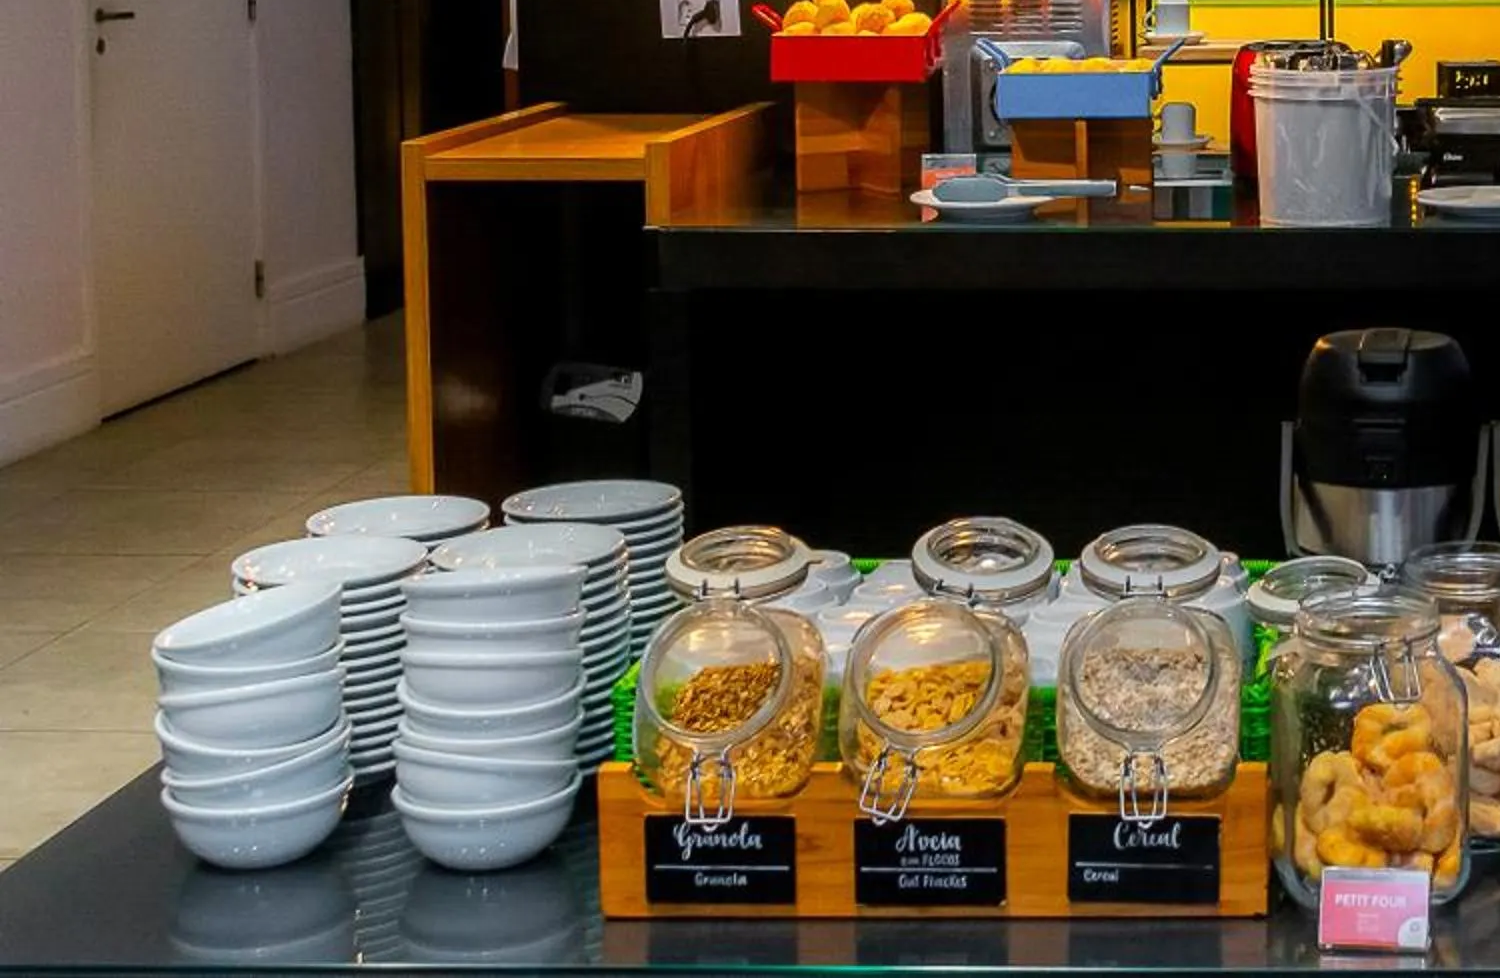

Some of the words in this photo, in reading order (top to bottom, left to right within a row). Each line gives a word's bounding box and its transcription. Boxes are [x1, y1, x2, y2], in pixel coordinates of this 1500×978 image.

[672, 821, 764, 862] Granola
[895, 823, 963, 854] Aveia
[1113, 821, 1184, 851] Cereal
[694, 872, 749, 888] Granola
[1083, 868, 1120, 884] Cereal
[1335, 893, 1368, 907] PETIT
